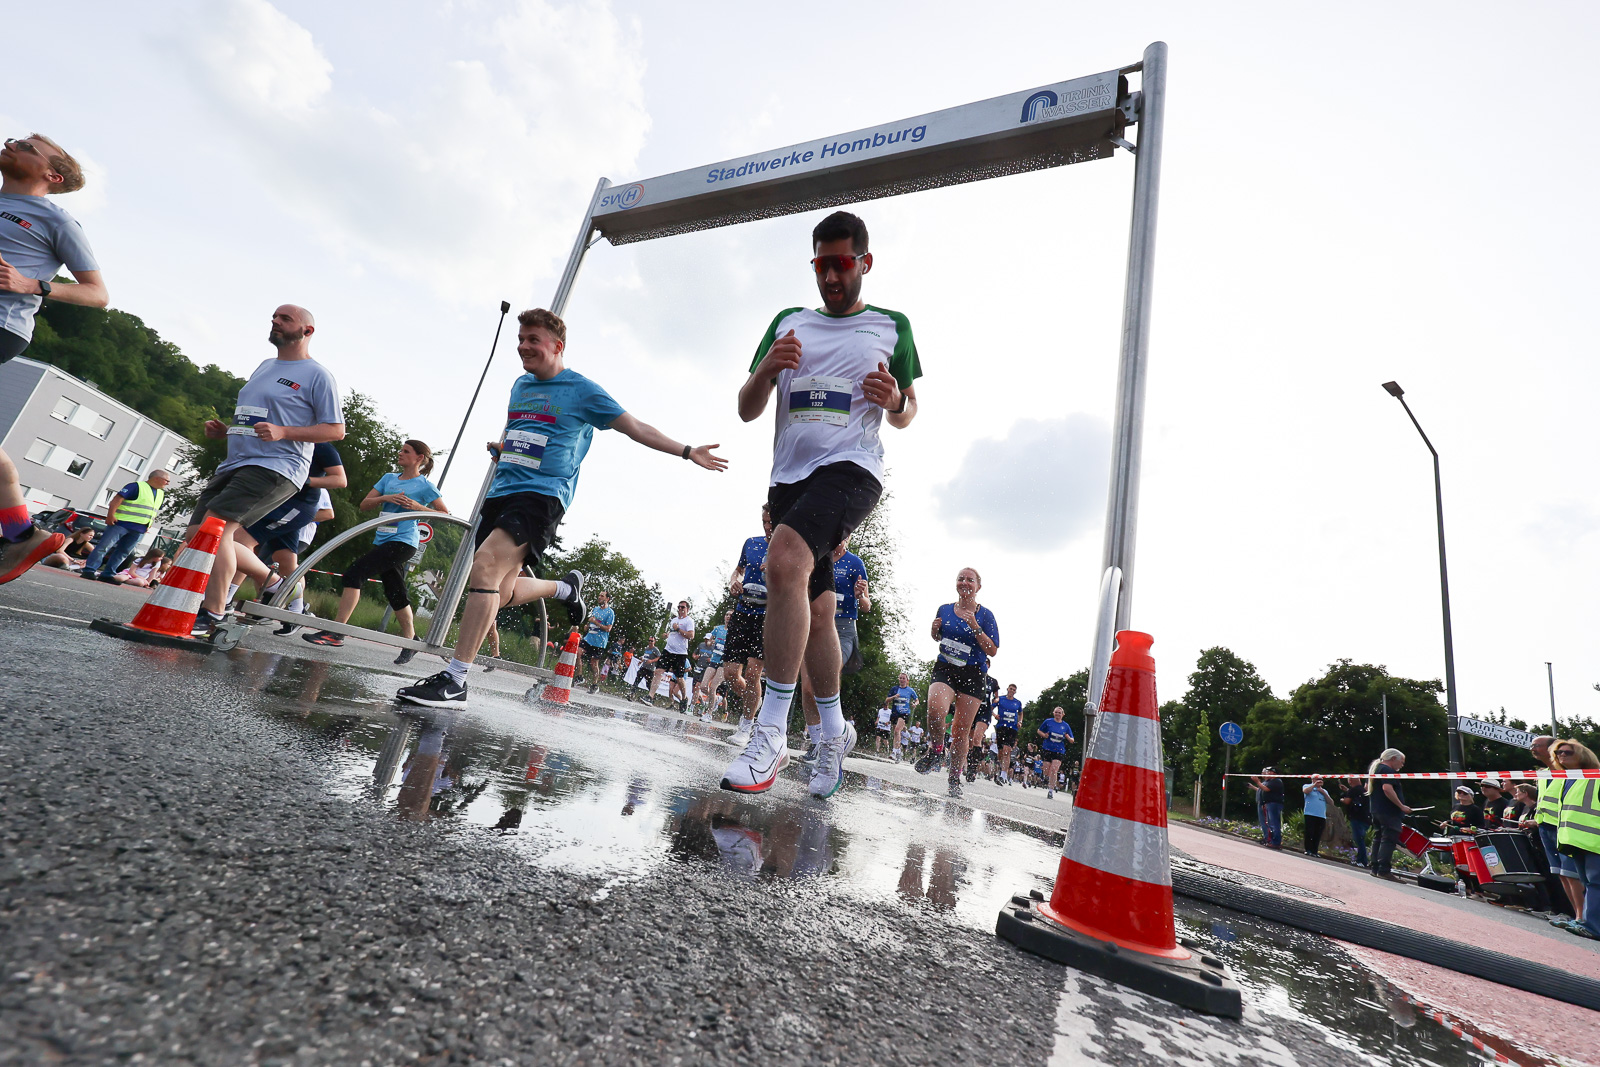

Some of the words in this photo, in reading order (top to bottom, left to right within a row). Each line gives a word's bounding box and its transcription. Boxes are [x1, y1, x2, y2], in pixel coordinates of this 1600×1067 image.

[1061, 83, 1111, 103] TRINK
[1041, 95, 1112, 118] WASSER
[706, 150, 814, 184] Stadtwerke
[820, 125, 928, 159] Homburg
[810, 391, 827, 400] Erik
[512, 440, 530, 450] Moritz
[1470, 727, 1528, 745] GOLFKLAUSE
